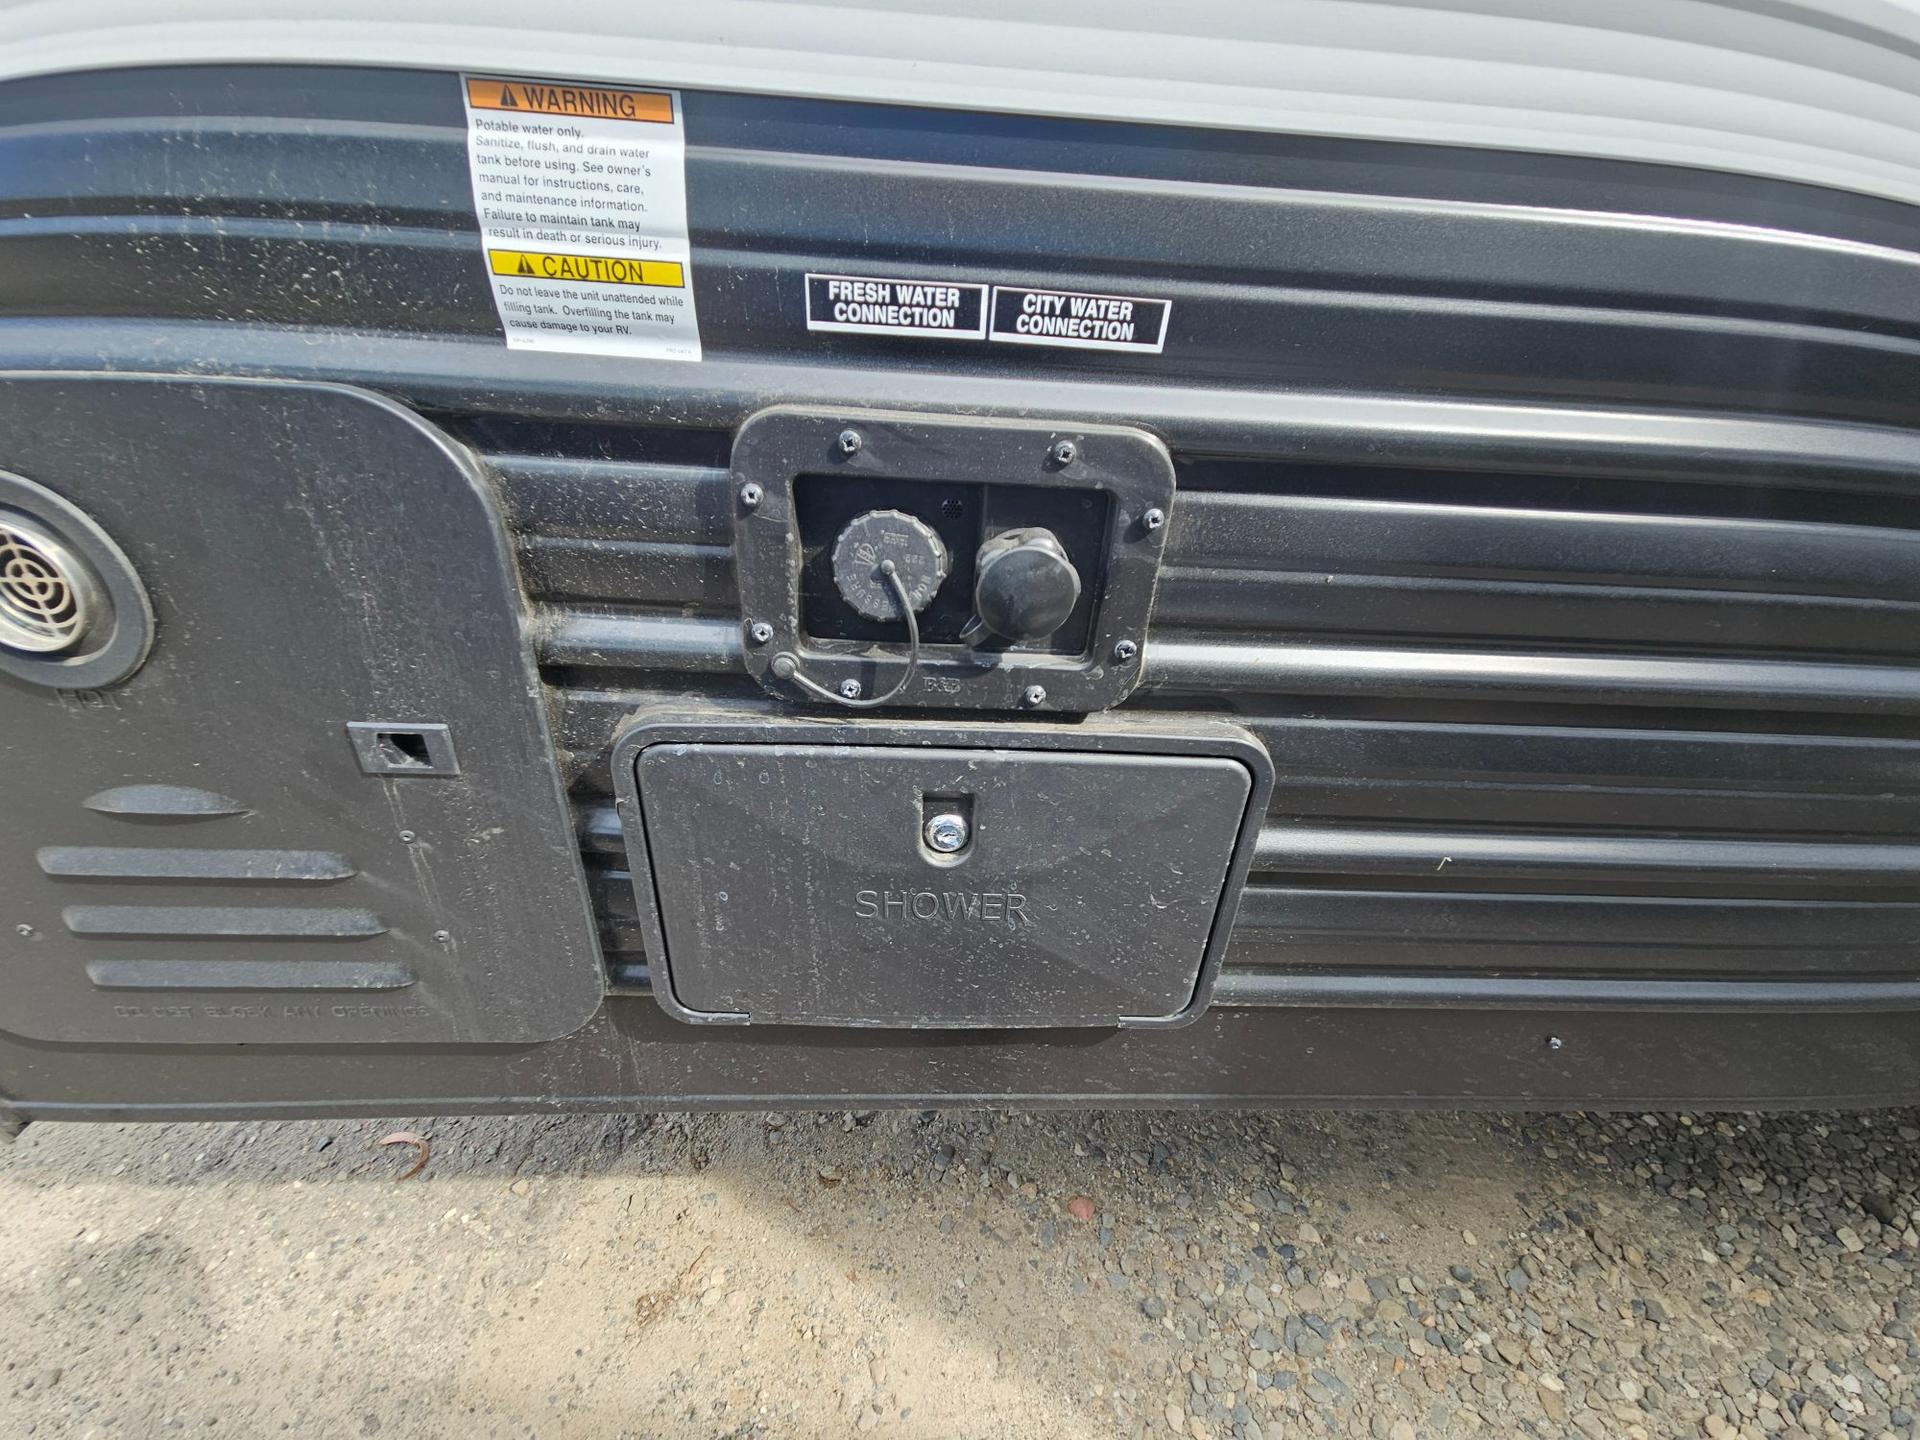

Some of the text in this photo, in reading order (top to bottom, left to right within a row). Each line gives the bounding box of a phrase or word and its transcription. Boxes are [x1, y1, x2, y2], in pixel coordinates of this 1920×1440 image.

[523, 86, 636, 117] WARNING
[475, 119, 584, 139] Potable water only.
[476, 136, 649, 159] Sanitize, flush, and drain water
[477, 155, 650, 176] tank before using. See owner's
[479, 173, 644, 195] manual for instructions, care,
[481, 191, 648, 212] and maintenance information.
[484, 208, 640, 232] Failure to maintain tank may
[489, 228, 662, 250] result in death or serious injury.
[542, 255, 643, 281] CAUTION
[500, 285, 683, 307] Do not leave the unit unattended while
[828, 280, 960, 308] FRESH WATER
[504, 302, 674, 324] filling tank. Overfilling the tank may
[834, 302, 955, 328] CONNECTION
[1023, 294, 1133, 321] CITY WATER
[510, 319, 631, 335] cause damage to your RV.
[1016, 315, 1134, 341] CONNECTION
[856, 890, 1033, 926] SHOWER
